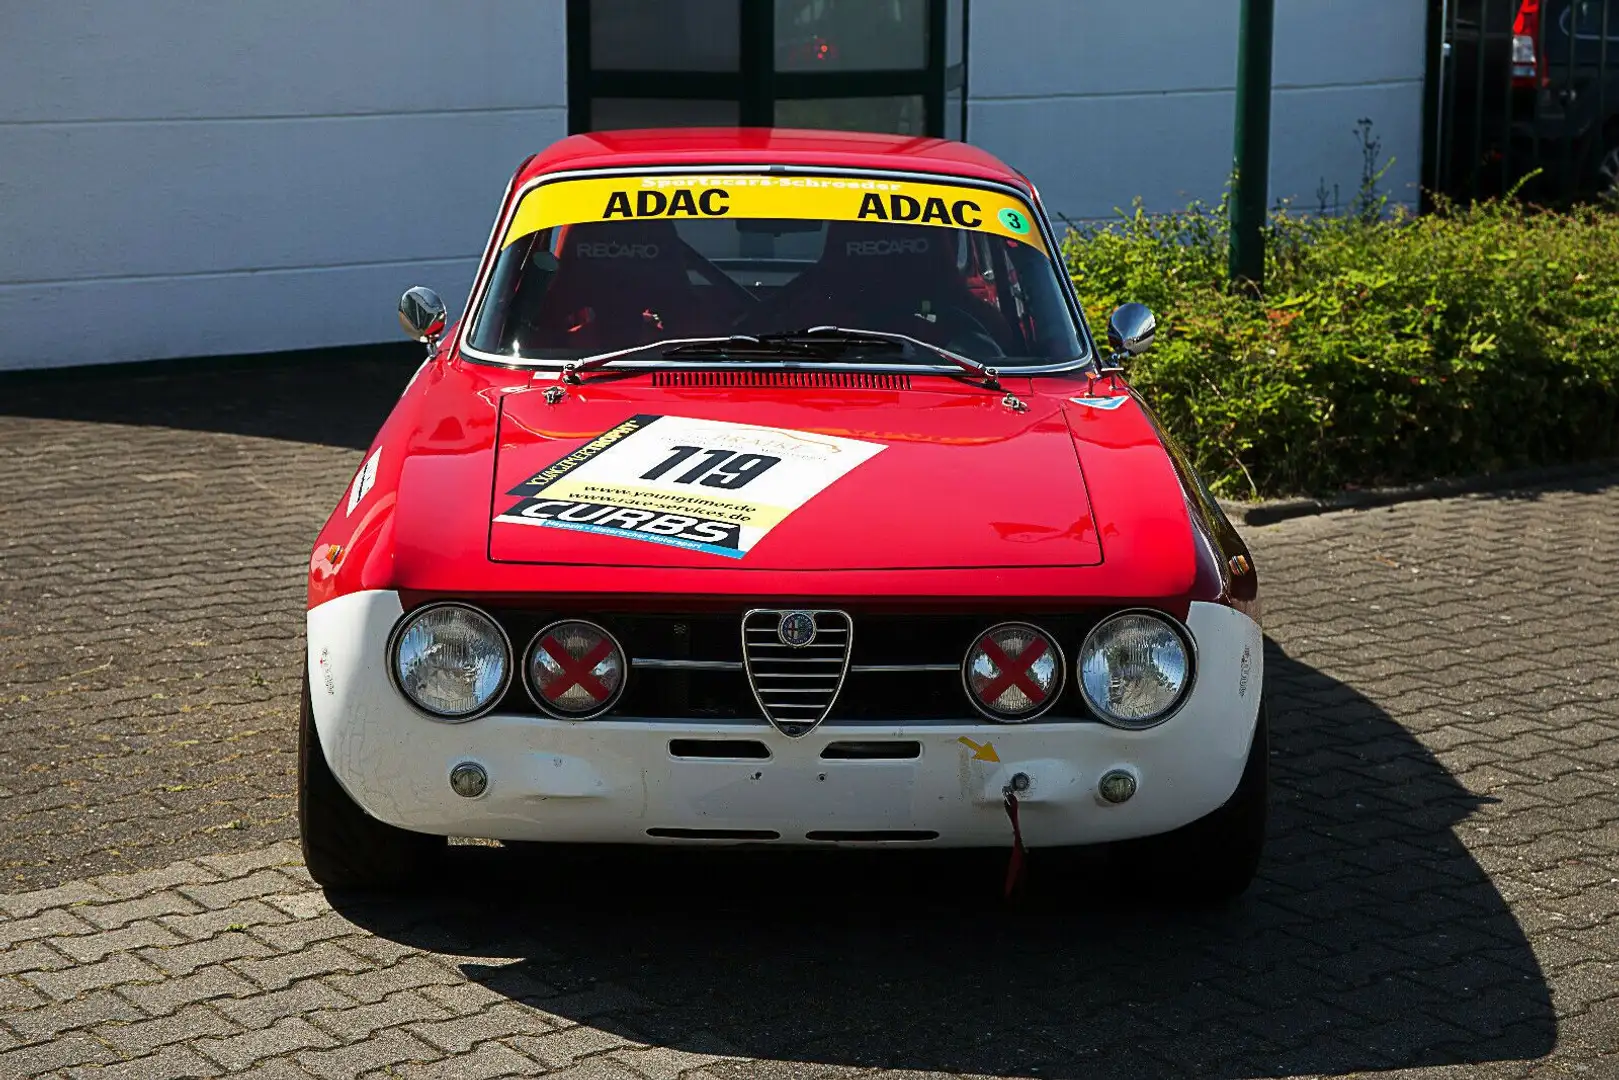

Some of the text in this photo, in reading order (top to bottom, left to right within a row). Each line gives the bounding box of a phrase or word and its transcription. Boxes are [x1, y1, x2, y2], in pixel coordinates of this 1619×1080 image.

[602, 188, 730, 218] ADAC
[857, 193, 982, 227] ADAC
[1007, 212, 1022, 229] 3
[577, 243, 660, 260] RECARO
[846, 238, 929, 257] RECARO
[638, 445, 782, 490] 119
[584, 486, 757, 512] www.youngtimer.de
[521, 500, 738, 543] CURBS
